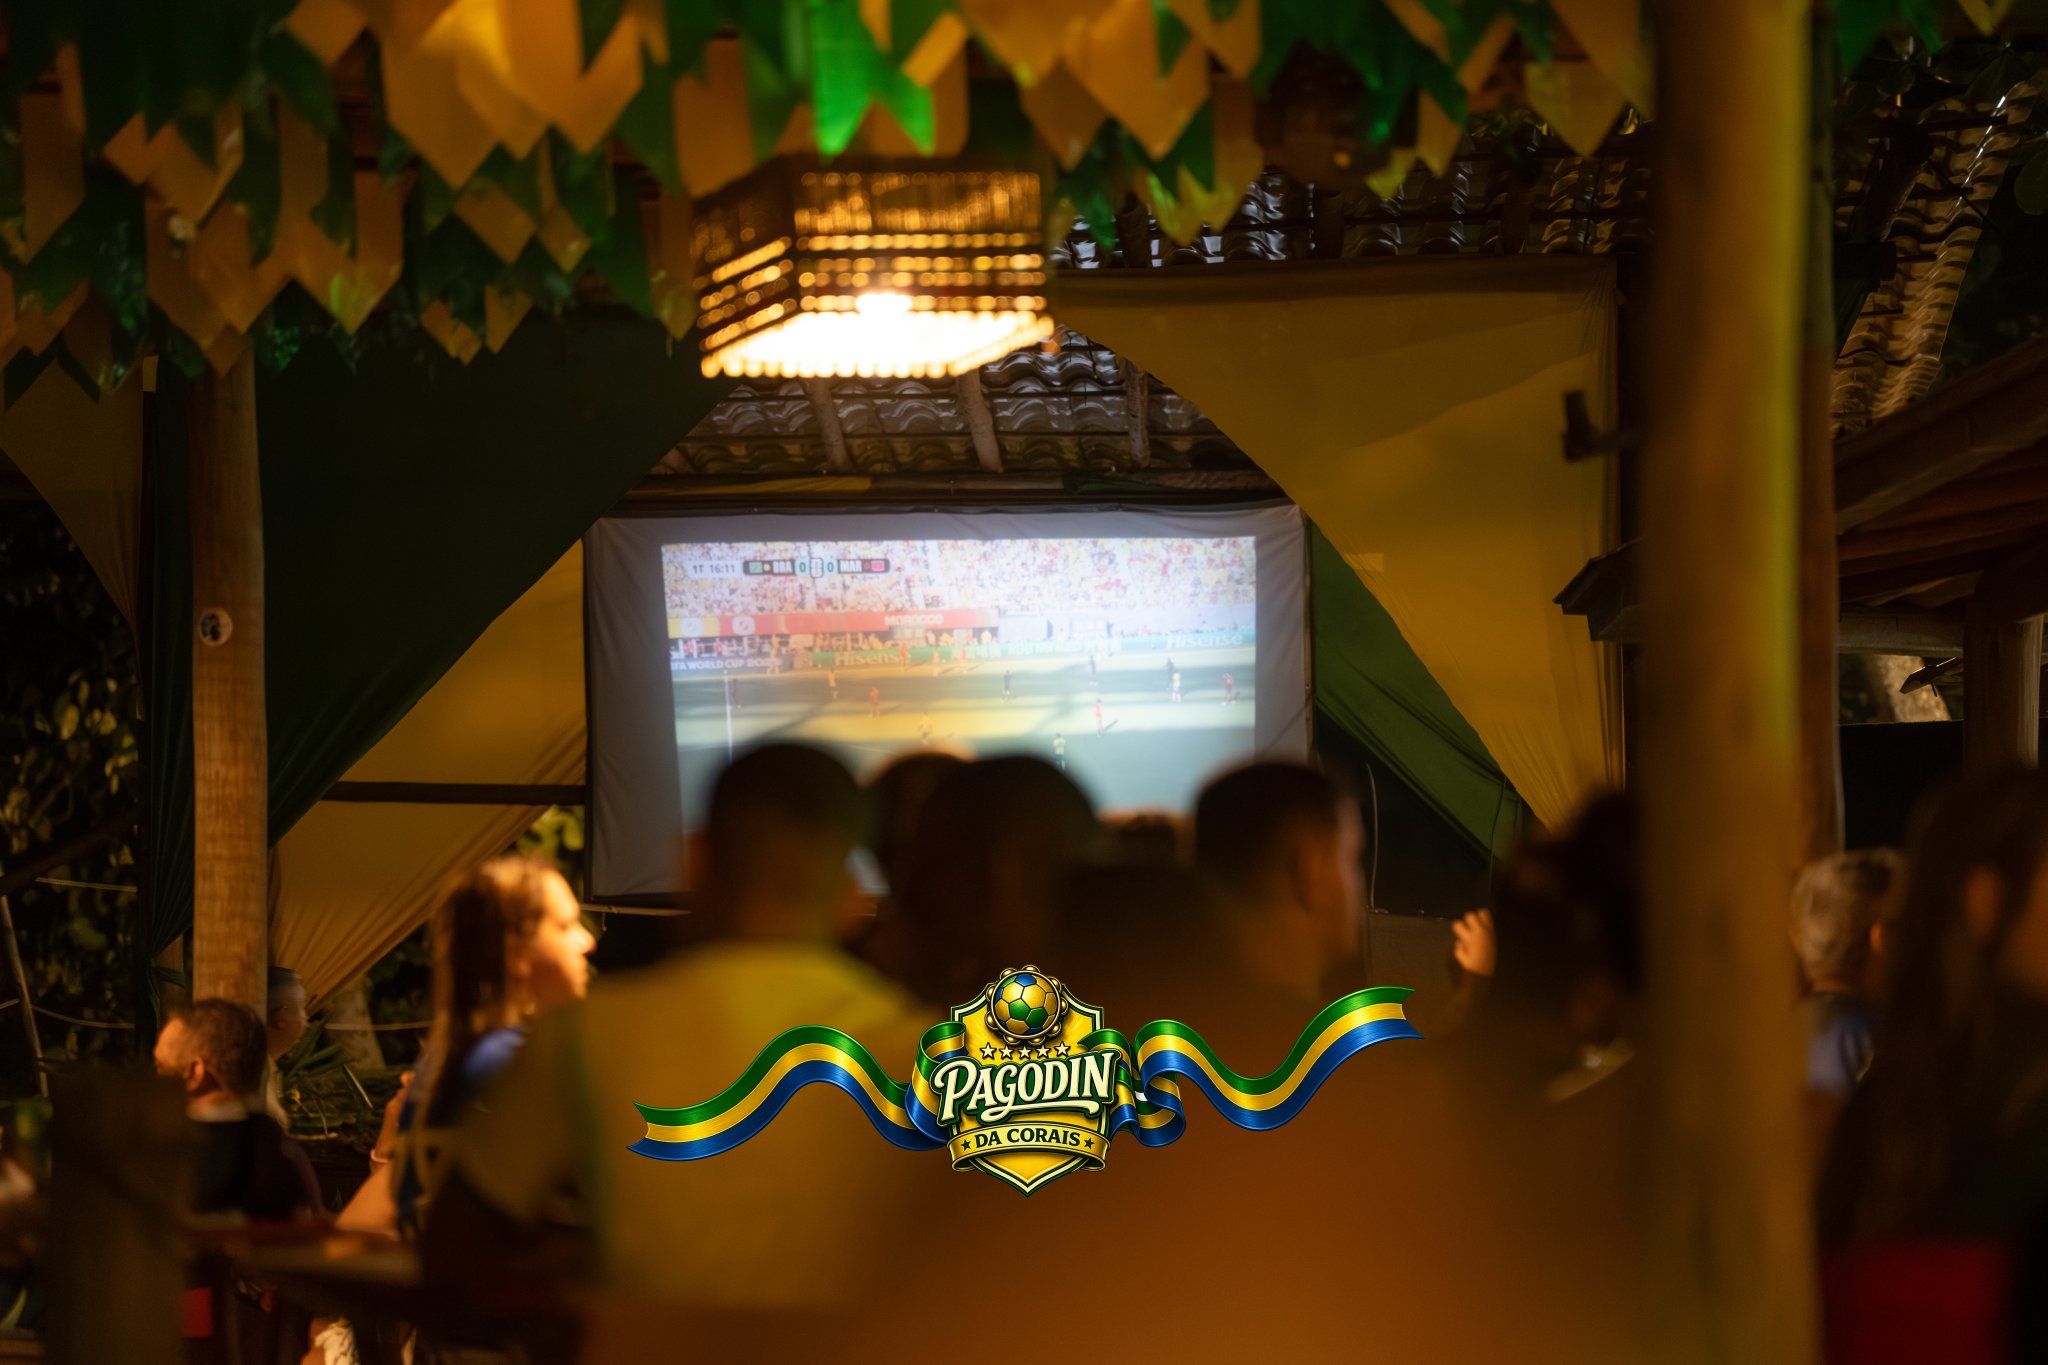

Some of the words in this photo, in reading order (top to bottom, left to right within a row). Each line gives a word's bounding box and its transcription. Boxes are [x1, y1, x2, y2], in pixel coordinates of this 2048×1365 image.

[692, 564, 704, 574] 1T
[709, 563, 735, 573] 16:11
[773, 561, 792, 574] BRA
[799, 562, 807, 573] 0
[827, 561, 834, 573] 0
[840, 560, 862, 572] MAR
[884, 613, 944, 625] MOROCCO
[1166, 634, 1243, 648] Hisense
[688, 660, 723, 670] WORLD
[725, 659, 745, 668] CUP
